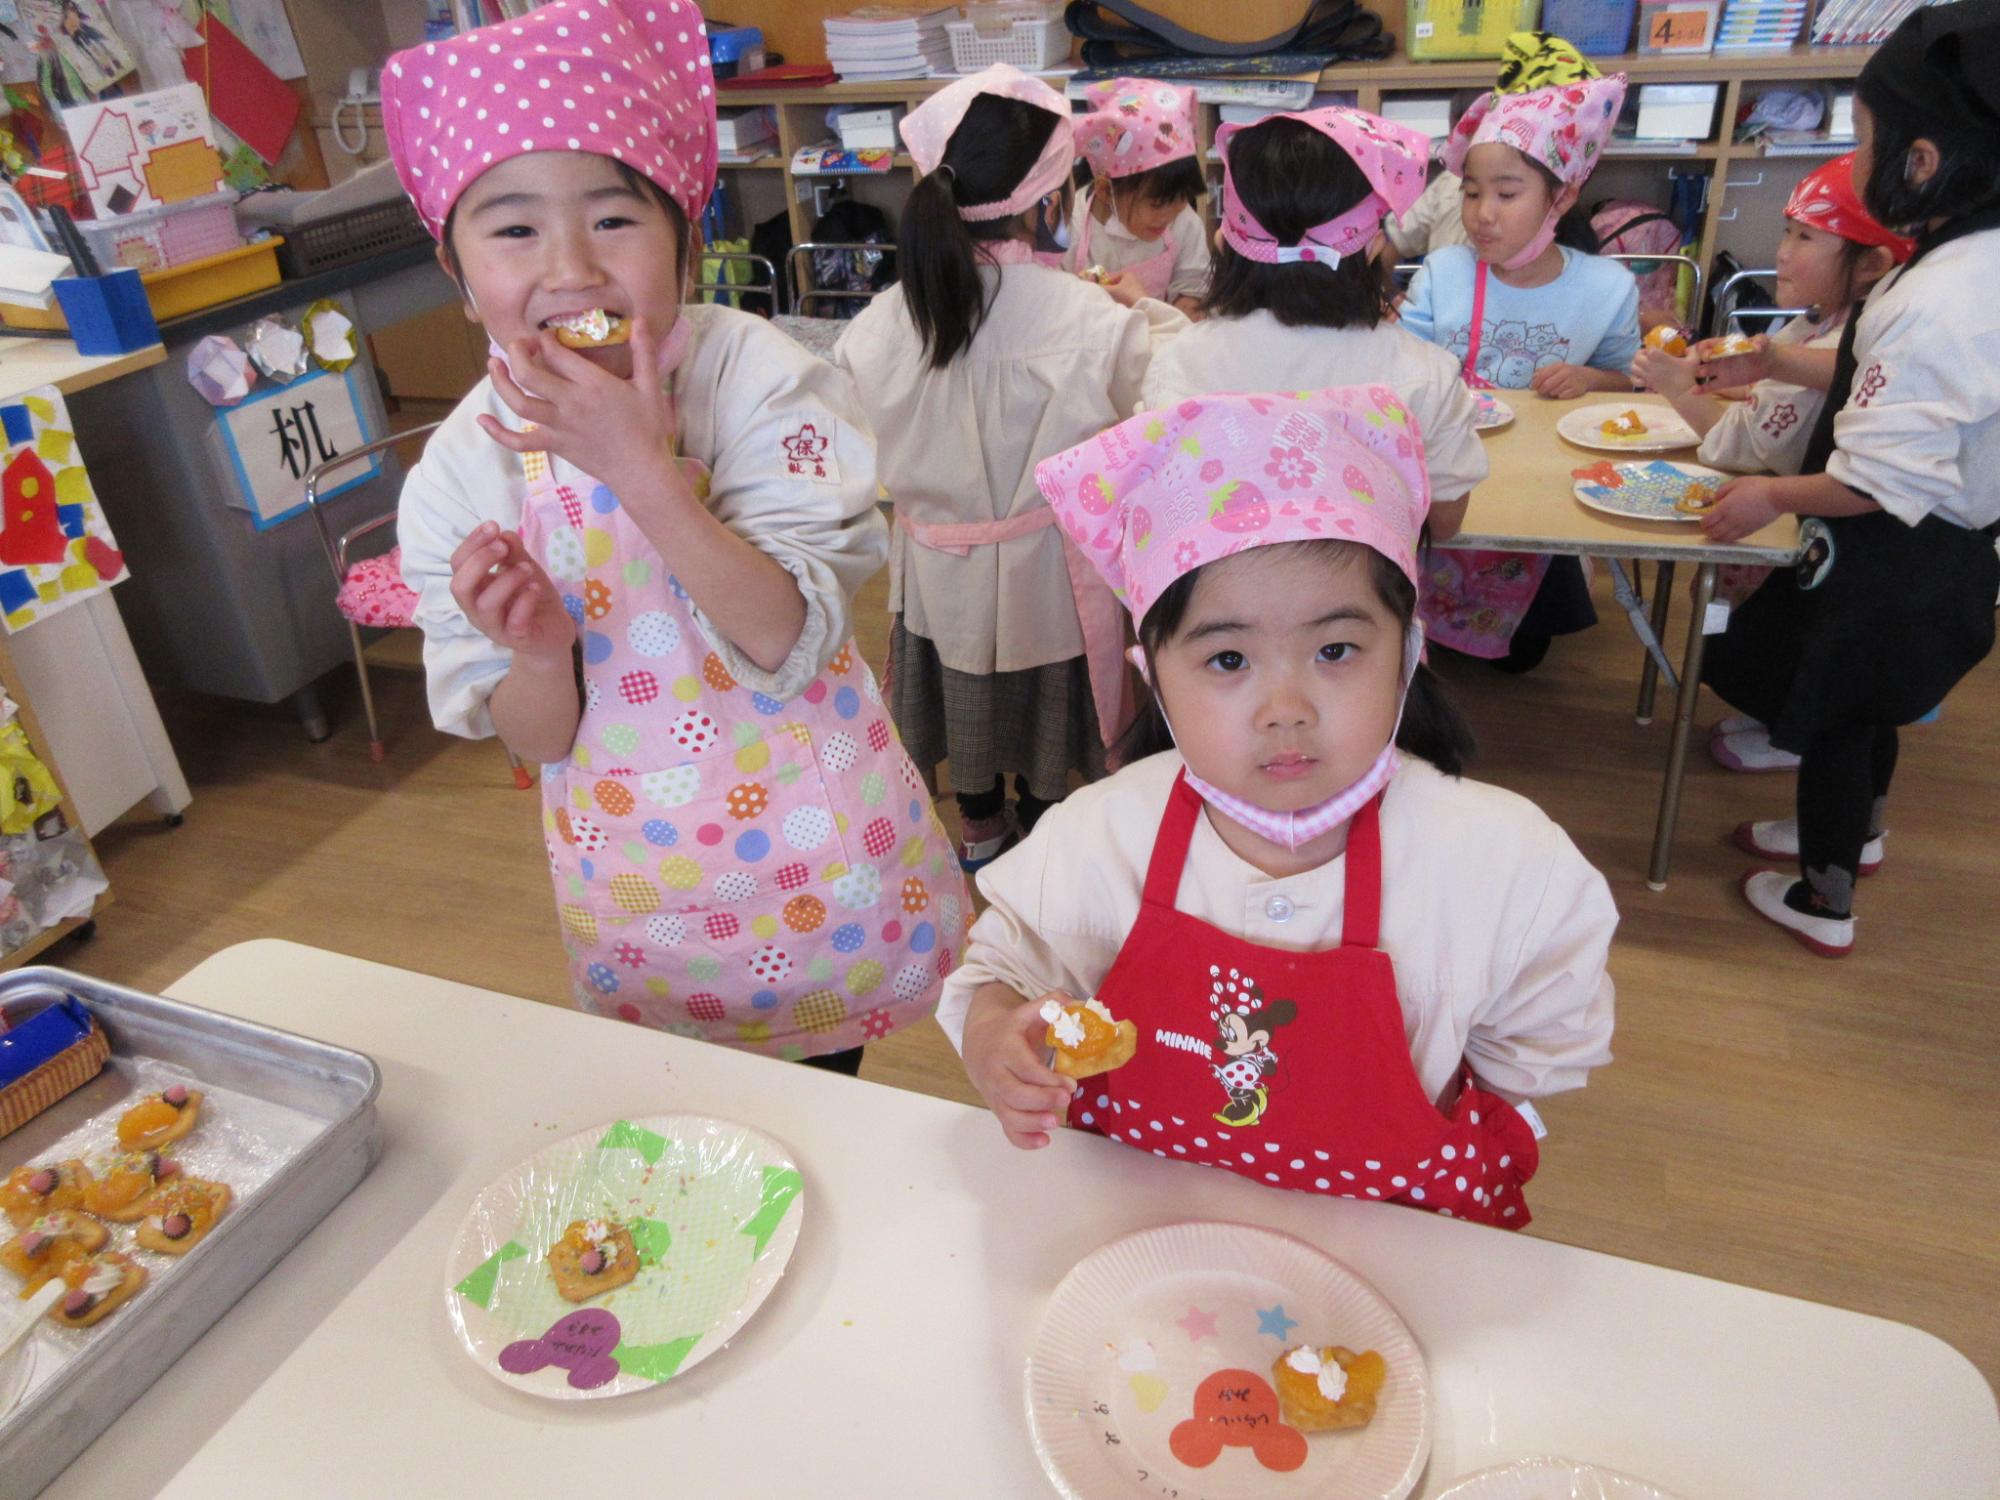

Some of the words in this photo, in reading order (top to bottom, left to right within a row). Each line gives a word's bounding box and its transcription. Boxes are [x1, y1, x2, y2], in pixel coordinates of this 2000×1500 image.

[268, 400, 339, 480] 机
[794, 439, 815, 456] 保
[1155, 1028, 1213, 1061] MINNIE
